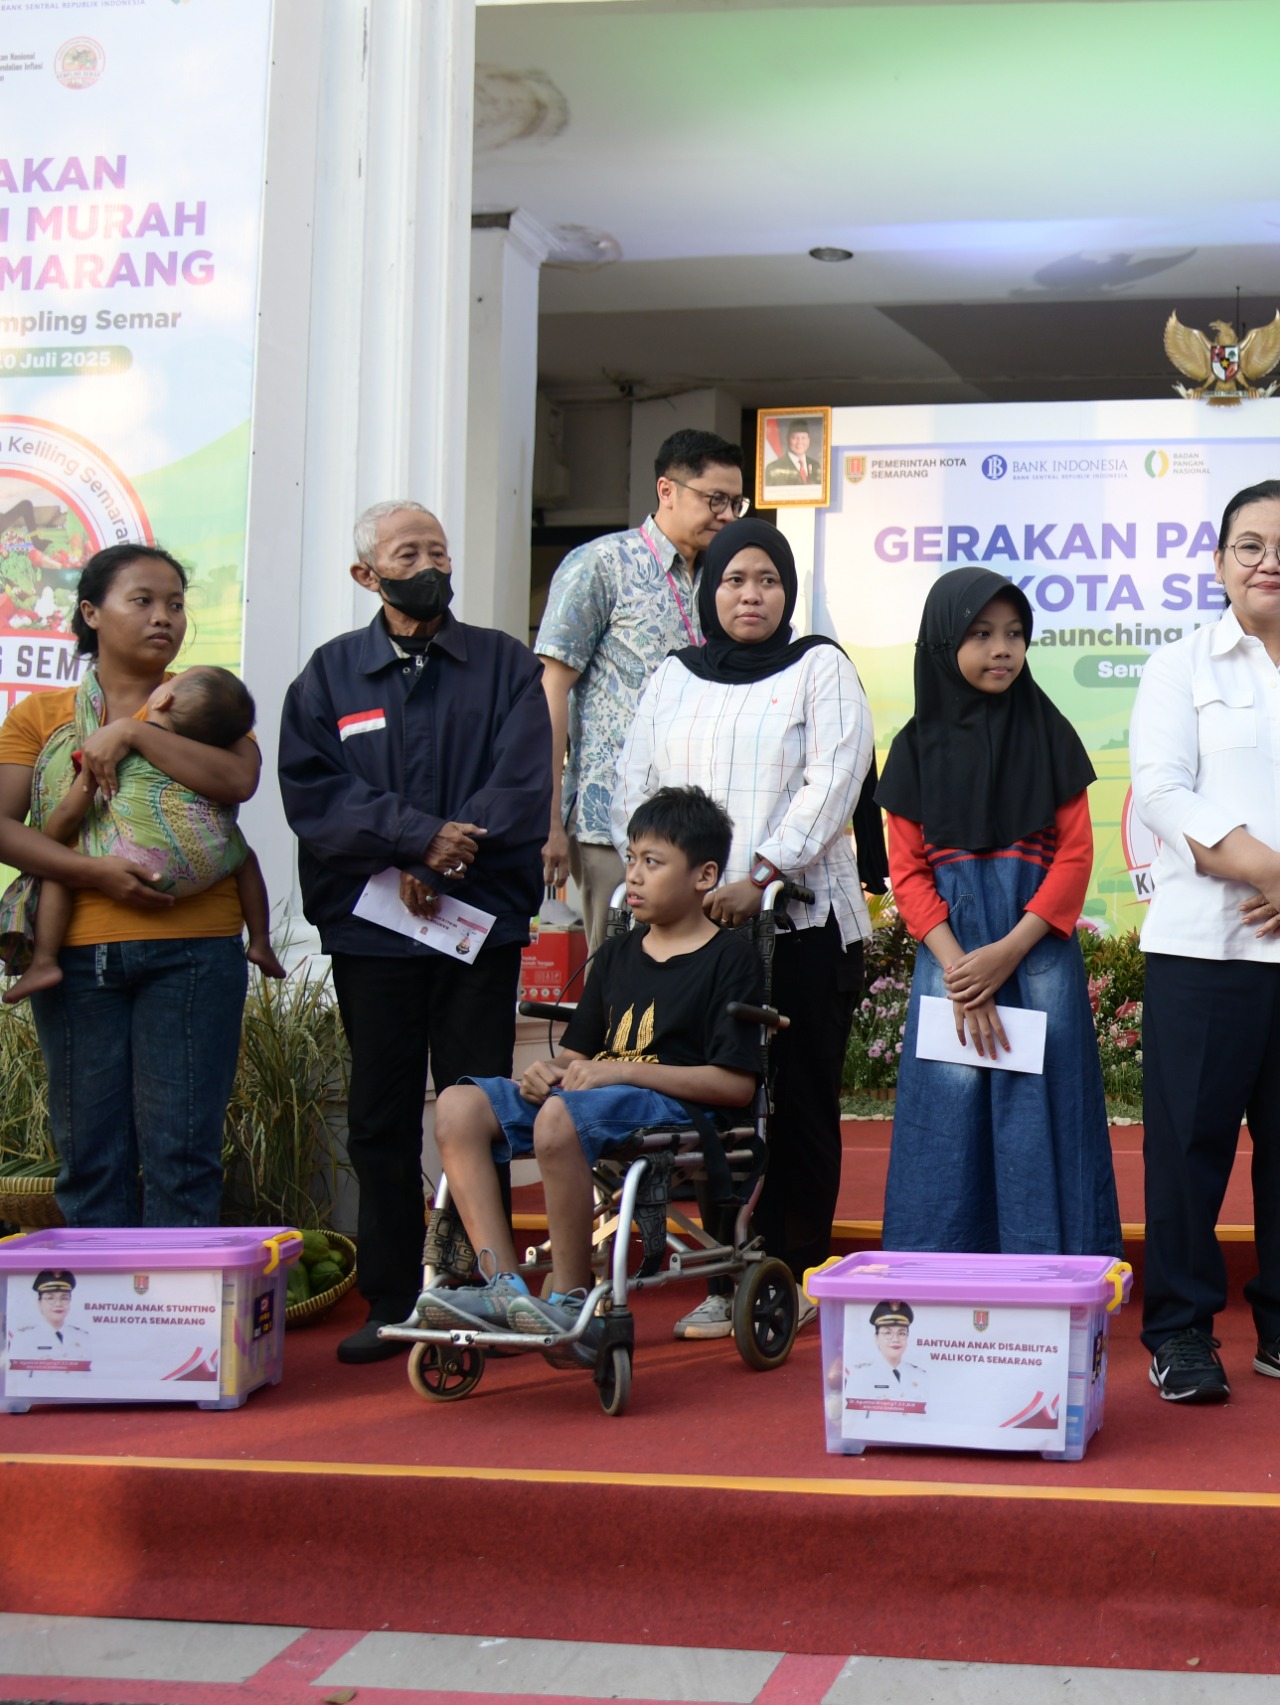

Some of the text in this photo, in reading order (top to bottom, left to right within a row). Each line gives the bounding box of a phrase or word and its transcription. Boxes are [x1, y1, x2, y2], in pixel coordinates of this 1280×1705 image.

[1, 3, 22, 11] BANK
[25, 2, 59, 10] SENTRAL
[62, 0, 98, 8] REPUBLIK
[26, 201, 207, 242] MURAH
[95, 309, 182, 331] Semar
[20, 352, 57, 369] Juli
[60, 350, 111, 368] 2025
[8, 435, 81, 477] Keliling
[871, 458, 967, 469] PEMERINTAH KOTA
[1013, 459, 1128, 473] BANK INDONESIA
[871, 470, 929, 479] SEMARANG
[873, 523, 1137, 563] GERAKAN
[84, 1302, 216, 1314] BANTUAN ANAK STUNTING
[93, 1315, 206, 1326] WALI KOTA SEMARANG
[916, 1338, 1059, 1353] BANTUAN ANAK DISABILITAS
[930, 1352, 1043, 1367] WALI KOTA SEMARANG
